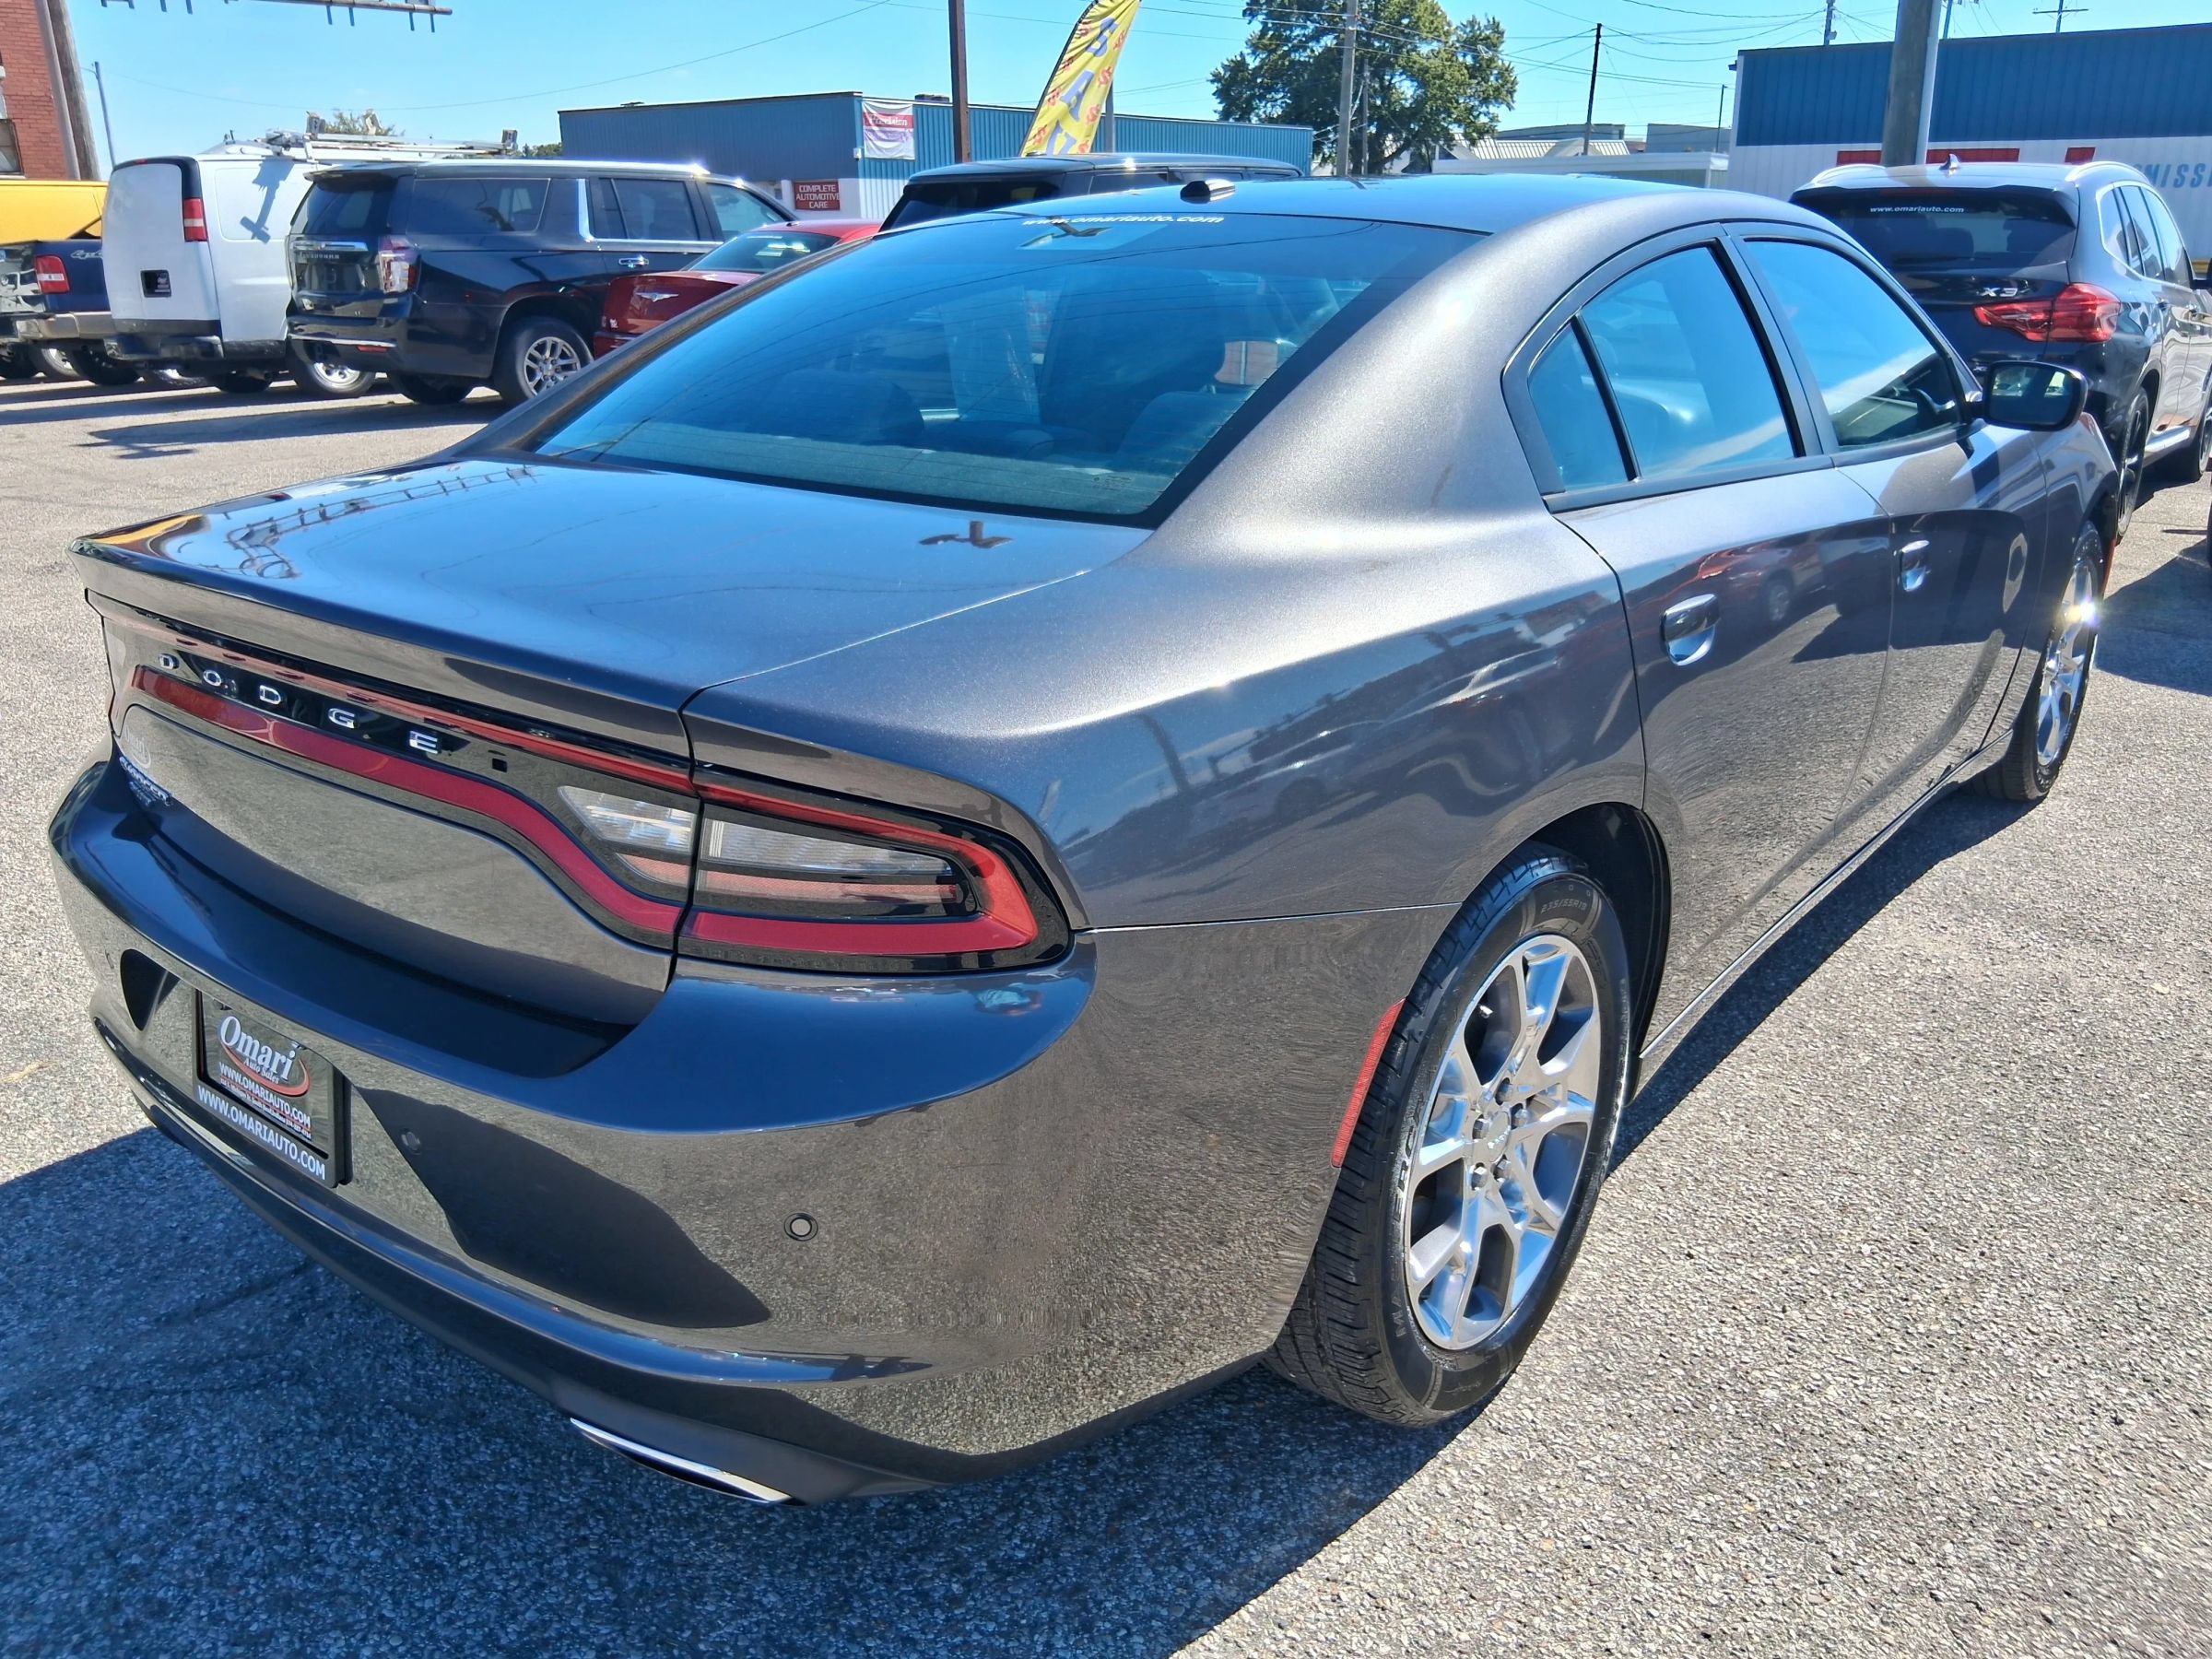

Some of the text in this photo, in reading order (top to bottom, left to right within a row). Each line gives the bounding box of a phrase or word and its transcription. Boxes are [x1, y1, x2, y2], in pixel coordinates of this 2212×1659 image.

[795, 193, 841, 201] AUTOMOTIVE
[798, 184, 837, 193] COMPLETE
[809, 201, 830, 209] CARE
[1022, 215, 1225, 224] www.omariauto.com
[1981, 287, 2018, 297] X3
[159, 653, 439, 755] DODGE
[220, 1016, 296, 1081] Omari
[243, 1058, 280, 1085] Auto Sales
[219, 1062, 311, 1128] WWW.OMARIAUTO.COM
[198, 1086, 325, 1180] WWW.OMARIAUTO.COM
